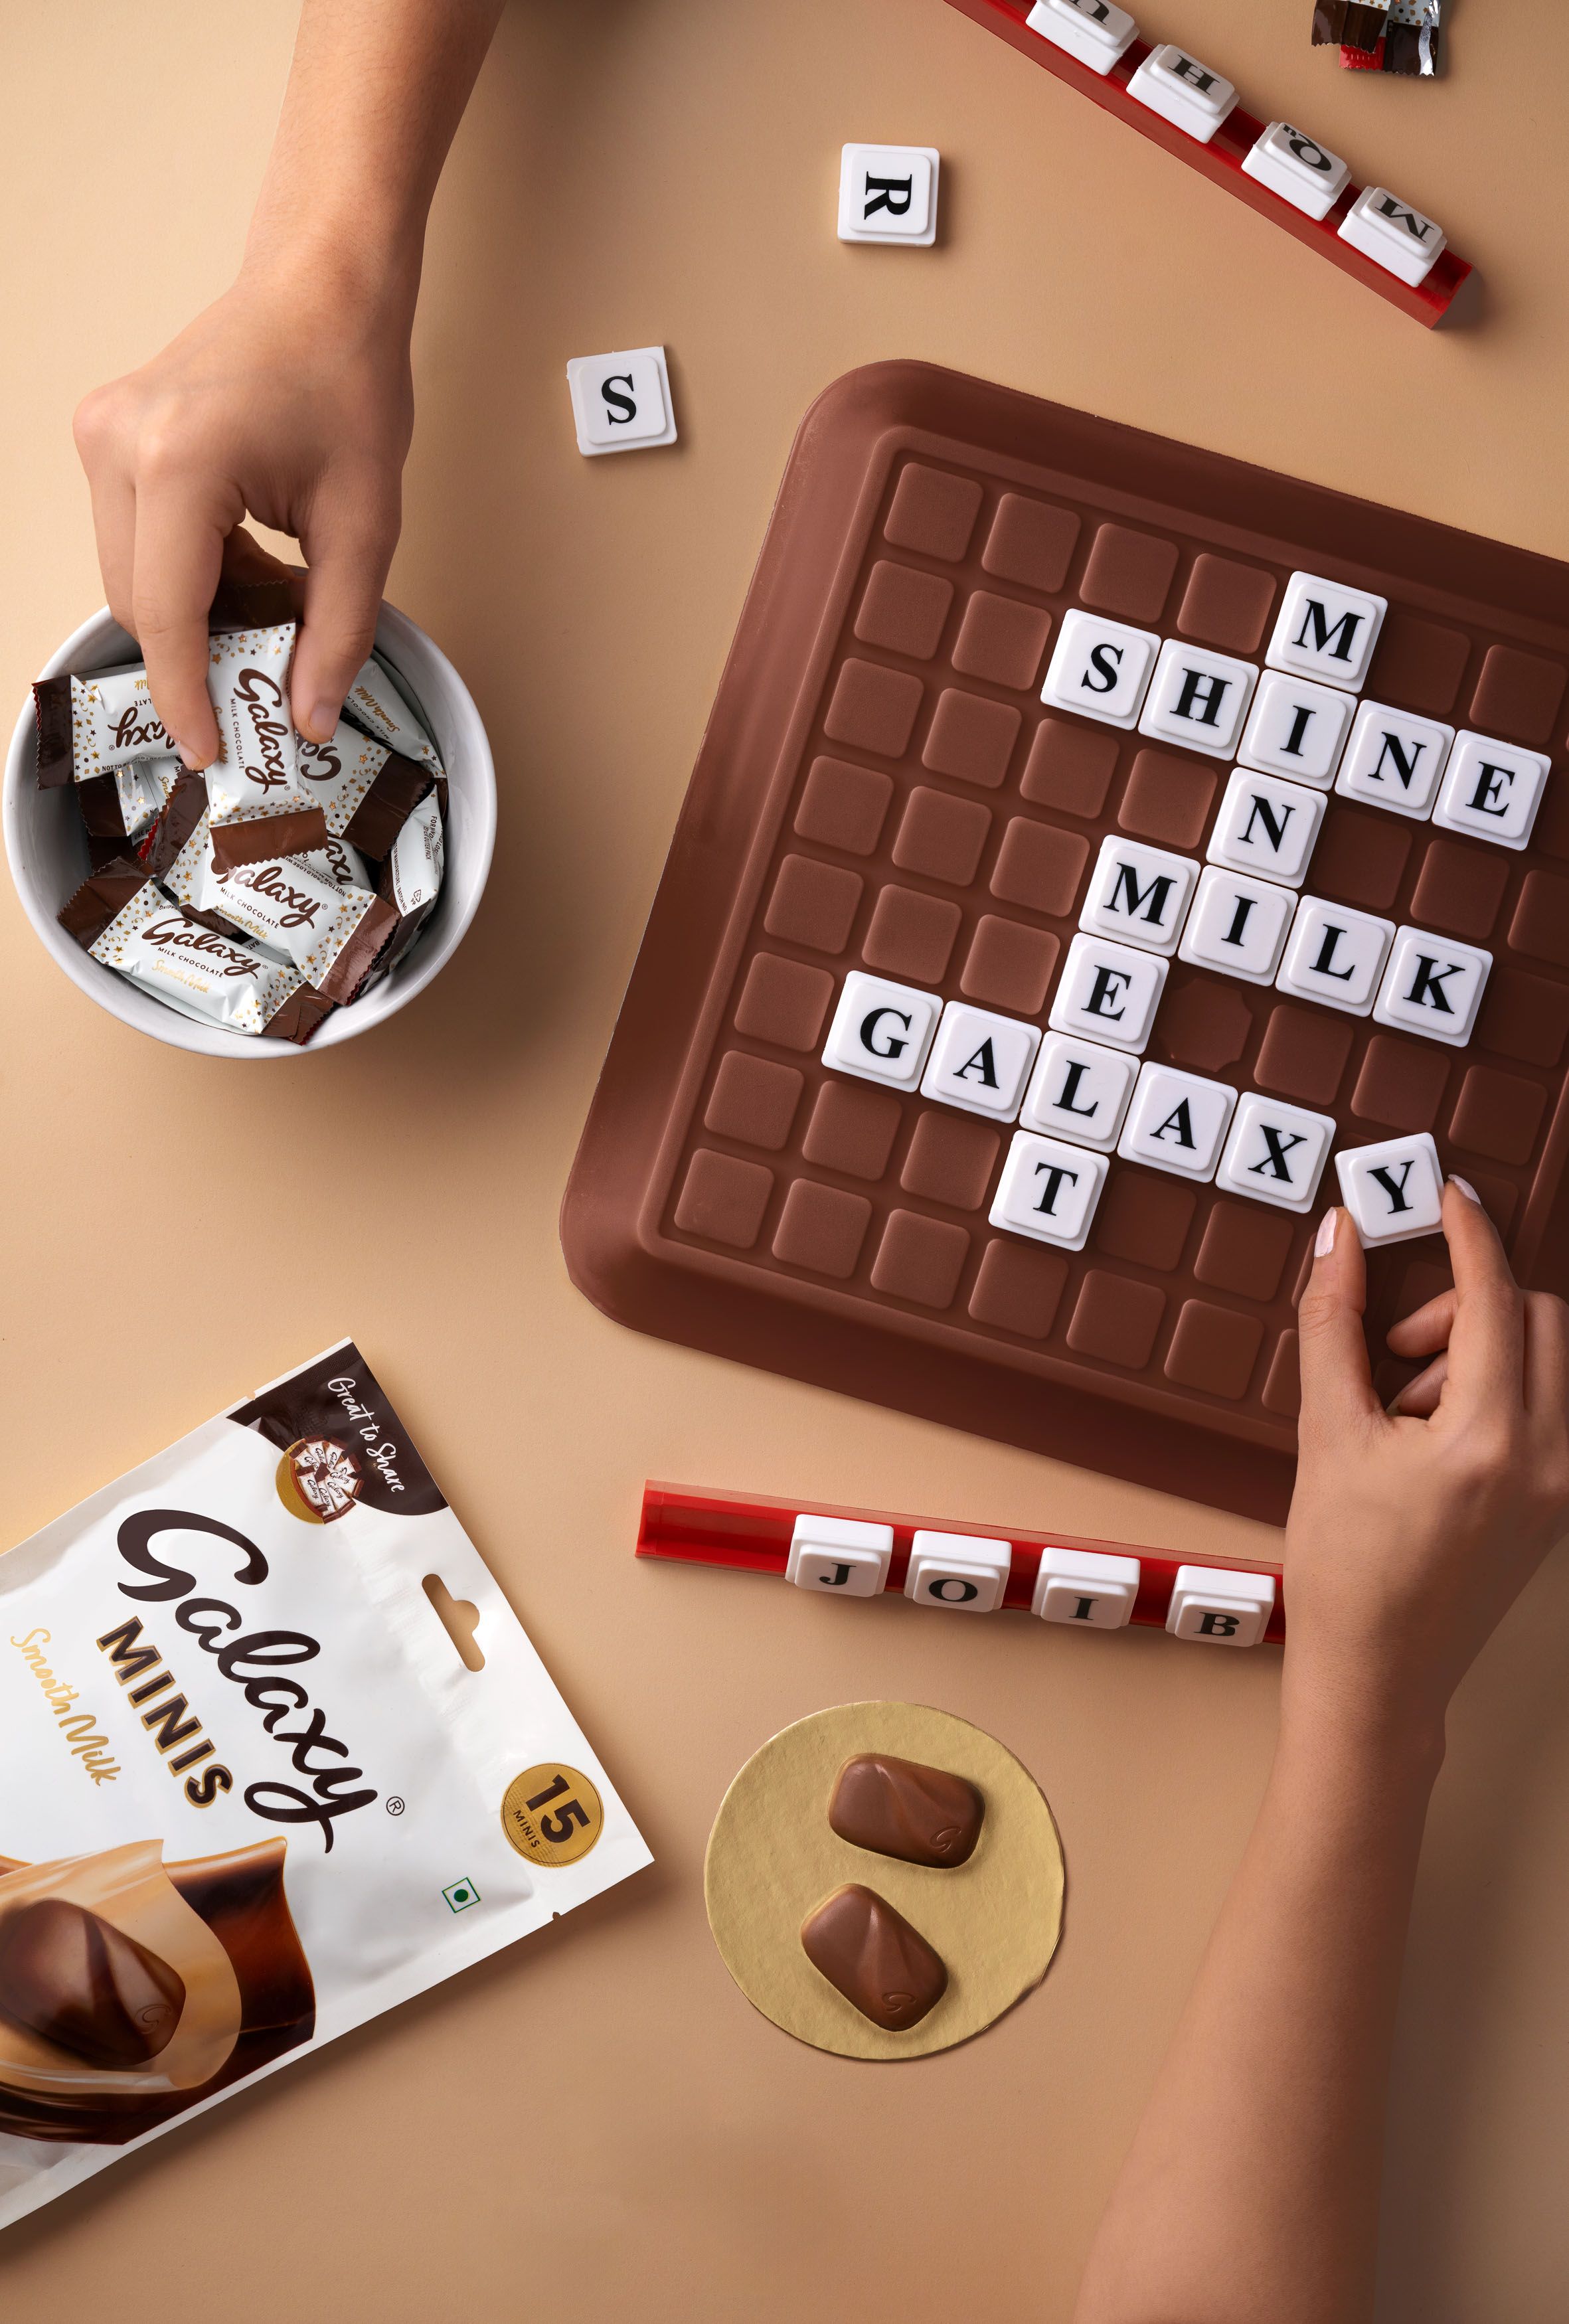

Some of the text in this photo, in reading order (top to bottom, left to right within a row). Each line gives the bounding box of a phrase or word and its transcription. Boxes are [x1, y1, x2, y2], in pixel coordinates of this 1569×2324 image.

[864, 171, 913, 220] R
[600, 373, 635, 426] S
[230, 698, 244, 770] MILK CHOCOLATE
[233, 668, 288, 795] Galaxy
[347, 696, 374, 724] CHOCOLA
[375, 725, 390, 740] MILK
[1081, 643, 1516, 818] SHINE
[220, 886, 280, 929] MILK CHOCOLATE
[244, 921, 269, 940] Milk
[141, 917, 261, 979] Galaxy
[157, 946, 224, 978] MILK CHOCOLATE
[1103, 861, 1465, 1015] MILK
[151, 959, 186, 983] Smooth
[327, 1377, 405, 1493] Great to Share
[307, 1479, 319, 1499] Galaxy
[327, 1481, 343, 1498] Galaxy
[330, 1471, 350, 1484] Galaxy
[10, 1627, 121, 1786] Smooth Milk
[117, 1509, 378, 1854] Galaxy
[96, 1616, 233, 1809] MINIS
[513, 1809, 540, 1848] MINIS
[526, 1774, 591, 1843] 15
